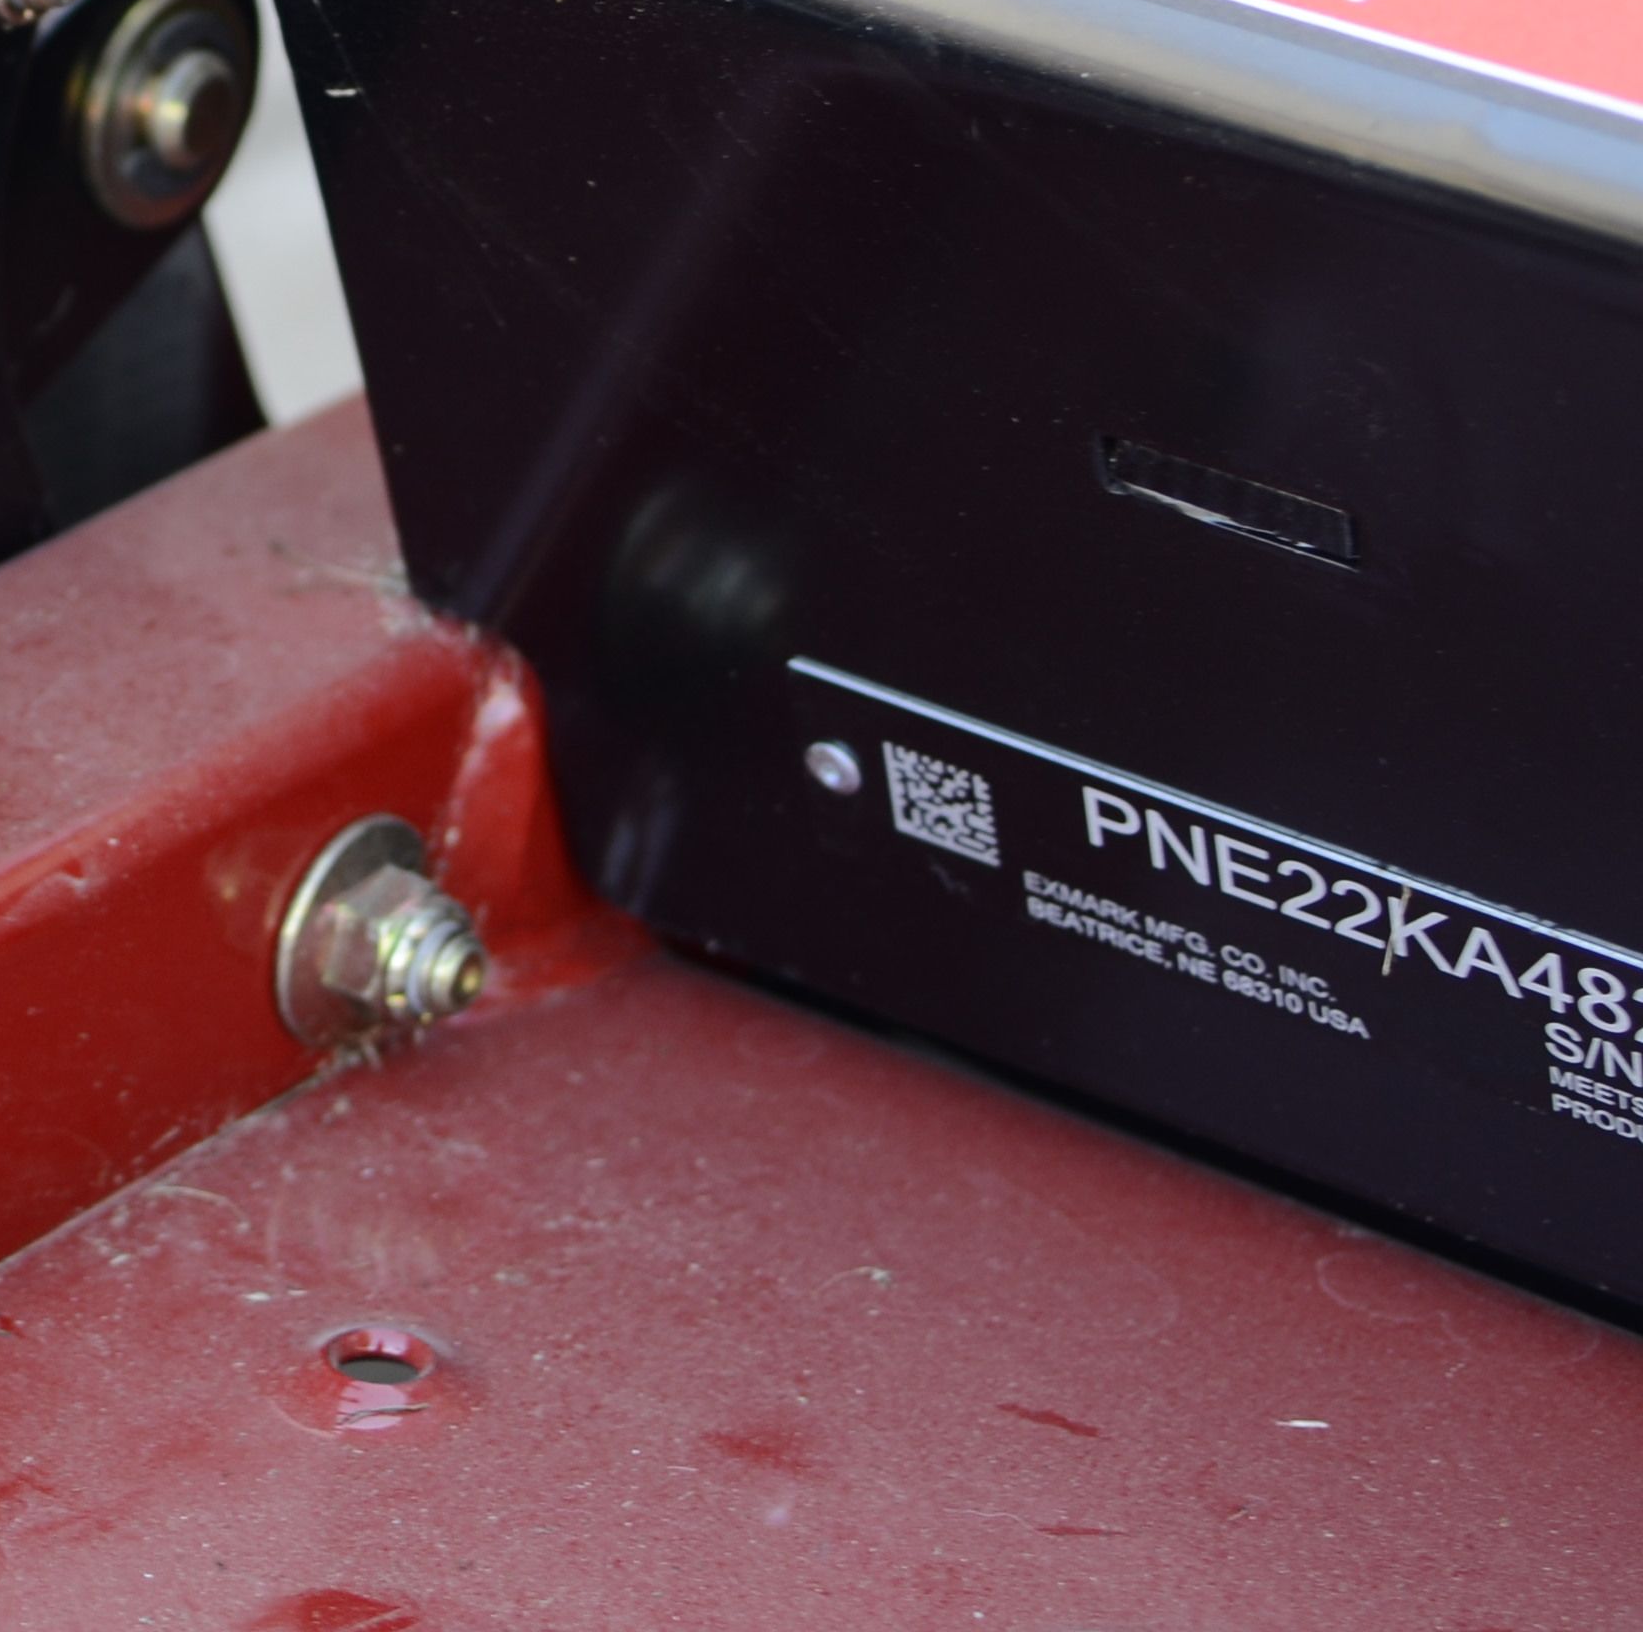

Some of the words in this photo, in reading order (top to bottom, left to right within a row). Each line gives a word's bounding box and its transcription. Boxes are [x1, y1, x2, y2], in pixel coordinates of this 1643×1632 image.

[1023, 870, 1140, 930] EXMARK
[1144, 915, 1215, 957] MFG.
[1220, 945, 1272, 978] CO.
[1278, 965, 1337, 1002] INC.
[1027, 896, 1172, 969] BEATRICE,
[1177, 952, 1218, 983] NE
[1222, 969, 1303, 1014] 68310
[1308, 1000, 1371, 1039] USA
[1082, 785, 1643, 1043] PNE22KA48
[1544, 1022, 1643, 1088] S/N
[1551, 1092, 1643, 1144] PROD
